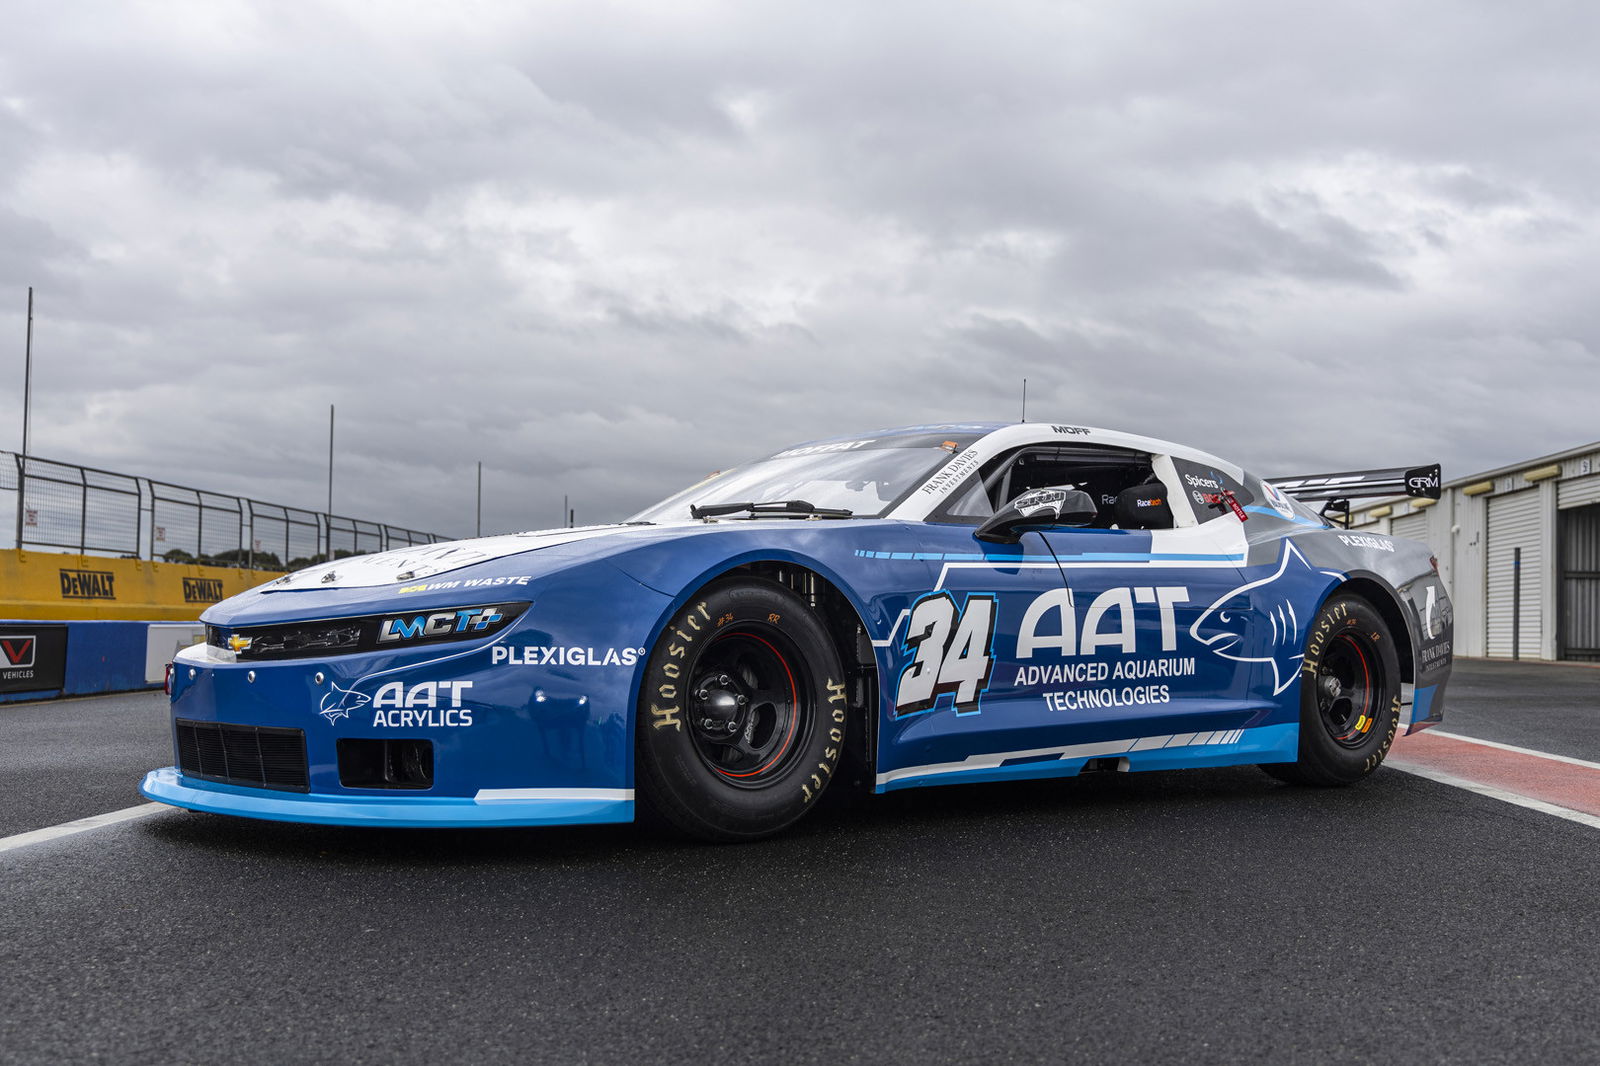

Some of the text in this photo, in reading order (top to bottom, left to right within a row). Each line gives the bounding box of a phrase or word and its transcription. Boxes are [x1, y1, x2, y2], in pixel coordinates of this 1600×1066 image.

[1051, 425, 1091, 436] MOFF
[922, 449, 979, 495] FRANK DAVIES
[938, 460, 979, 494] INVESTMENTS
[1185, 474, 1219, 489] Spicers
[1408, 477, 1439, 488] GRM
[1202, 493, 1221, 504] BOS
[60, 572, 115, 597] DeWALT
[183, 580, 222, 601] DeWALT
[427, 580, 461, 590] WM
[464, 575, 532, 587] WASTE
[1016, 586, 1190, 659] AAT
[894, 589, 999, 720] 34
[1301, 602, 1348, 681] Hoosier
[3, 670, 34, 680] VEHICLES
[651, 601, 711, 732] Hoosier
[1013, 657, 1196, 687] ADVANCED AQUARIUM
[372, 680, 473, 709] AAT
[1042, 684, 1170, 712] TECHNOLOGIES
[373, 709, 473, 728] ACRYLICS
[800, 678, 848, 804] Hoosier
[1365, 695, 1401, 772] Hoosier
